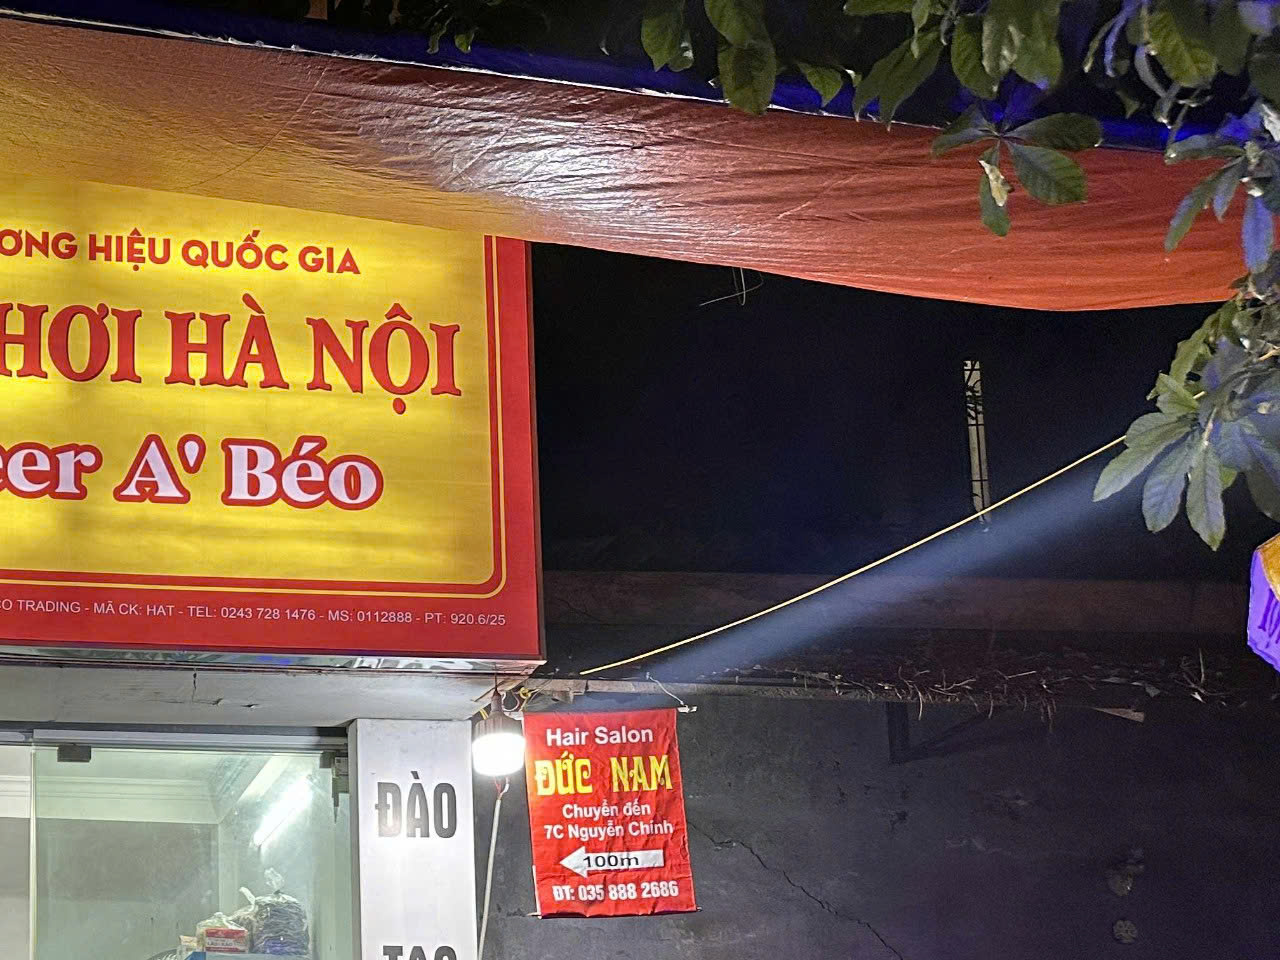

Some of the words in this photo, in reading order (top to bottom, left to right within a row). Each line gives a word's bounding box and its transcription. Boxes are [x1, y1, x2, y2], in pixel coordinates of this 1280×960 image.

[88, 227, 171, 271] HIỆU
[181, 229, 289, 270] QUỐC
[298, 246, 361, 275] GIA
[164, 292, 290, 390] HÀ
[306, 302, 462, 415] NỘI
[221, 435, 384, 511] Béo
[17, 600, 80, 613] TRADING
[93, 600, 115, 614] MÃ
[119, 603, 142, 616] CK:
[147, 604, 175, 616] HAT
[187, 606, 217, 618] TEL:
[221, 607, 252, 619] 0243
[256, 608, 280, 620] 728
[285, 609, 316, 621] 1476
[328, 610, 353, 622] MS:
[357, 610, 412, 623] 0112888
[424, 612, 446, 624] PT:
[546, 728, 589, 746] Hair
[595, 726, 653, 744] Salon
[534, 751, 593, 796] ĐỨC
[610, 755, 673, 793] NAM
[375, 771, 457, 838] ĐÀO
[562, 799, 619, 821] Chuyển
[623, 798, 651, 816] đến
[544, 825, 564, 840] 7C
[568, 820, 624, 841] Nguyễn
[629, 819, 674, 837] Chính
[583, 855, 640, 868] 100m
[552, 885, 575, 901] ĐT:
[578, 884, 604, 901] 035
[608, 883, 637, 900] 888
[641, 881, 679, 898] 2686
